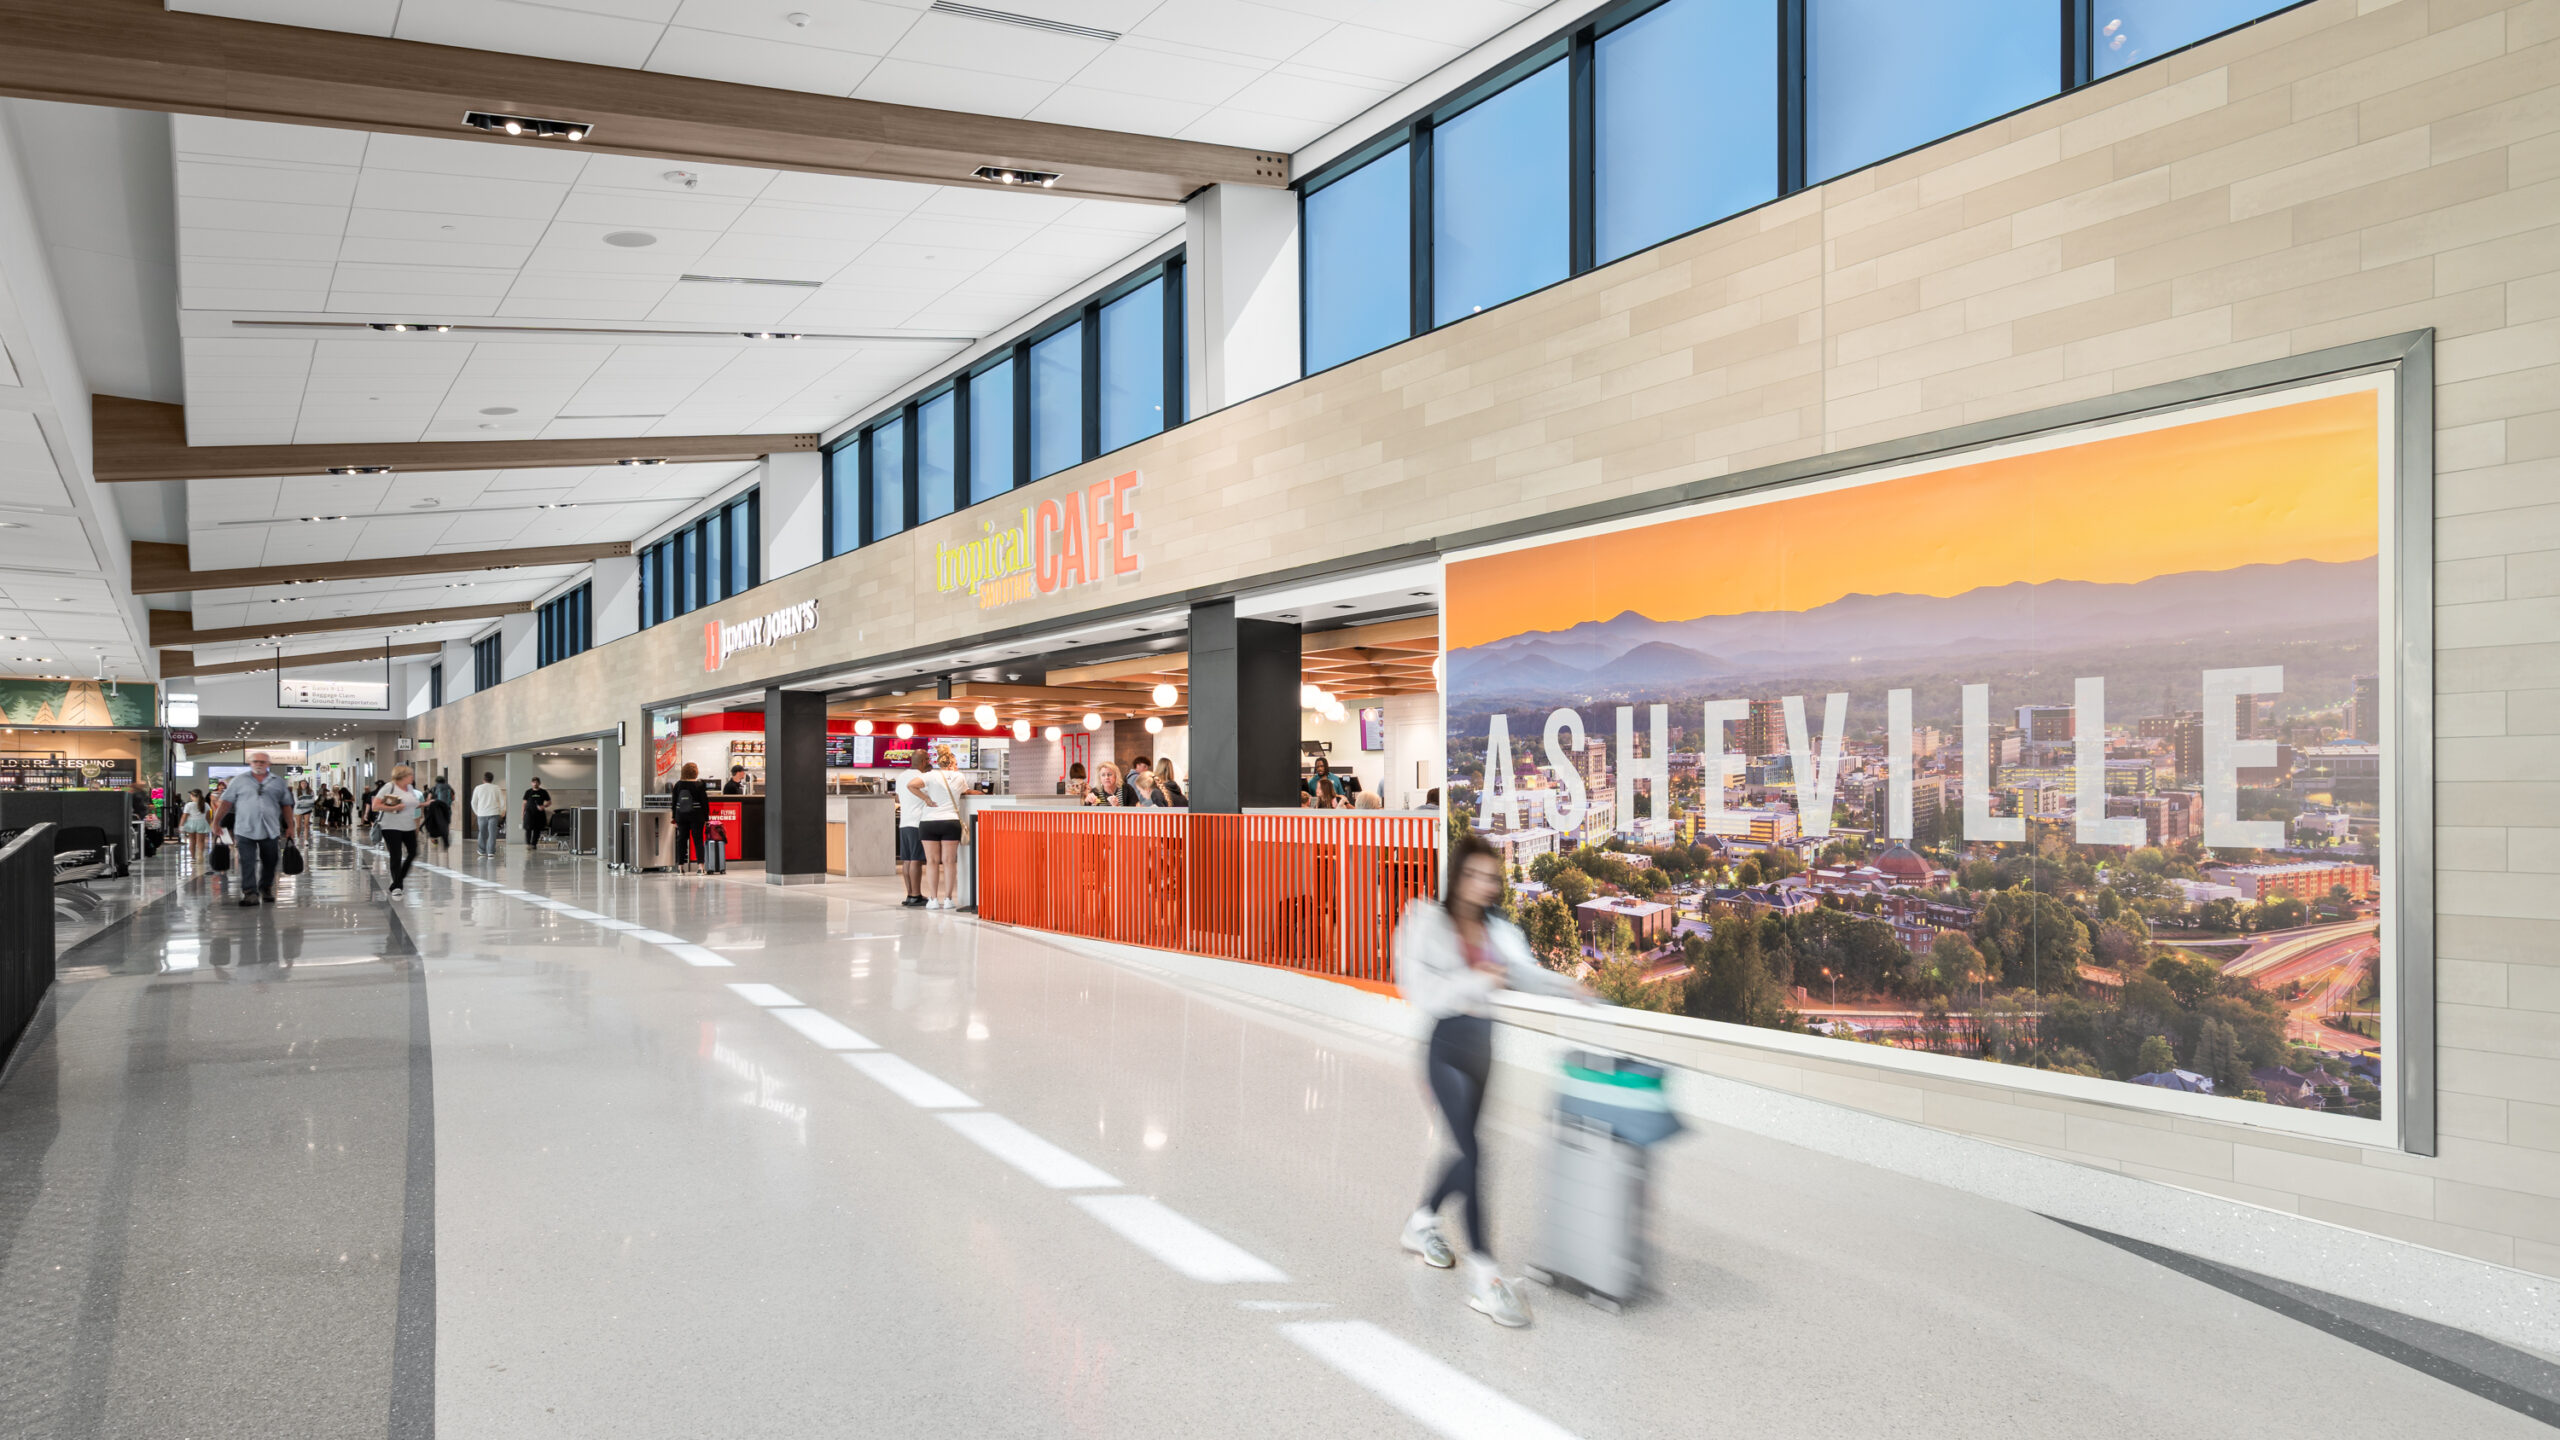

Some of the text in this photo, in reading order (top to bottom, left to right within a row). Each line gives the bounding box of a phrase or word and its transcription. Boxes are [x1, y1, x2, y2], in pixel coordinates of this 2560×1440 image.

[936, 508, 1034, 596] tropical
[1036, 470, 1142, 595] CAFE
[979, 571, 1033, 610] SMOOTHIE
[721, 617, 766, 659] JIMMY
[766, 599, 819, 646] JOHN'S
[34, 760, 116, 768] RERESHING
[1478, 665, 2286, 849] ASHEVILLE
